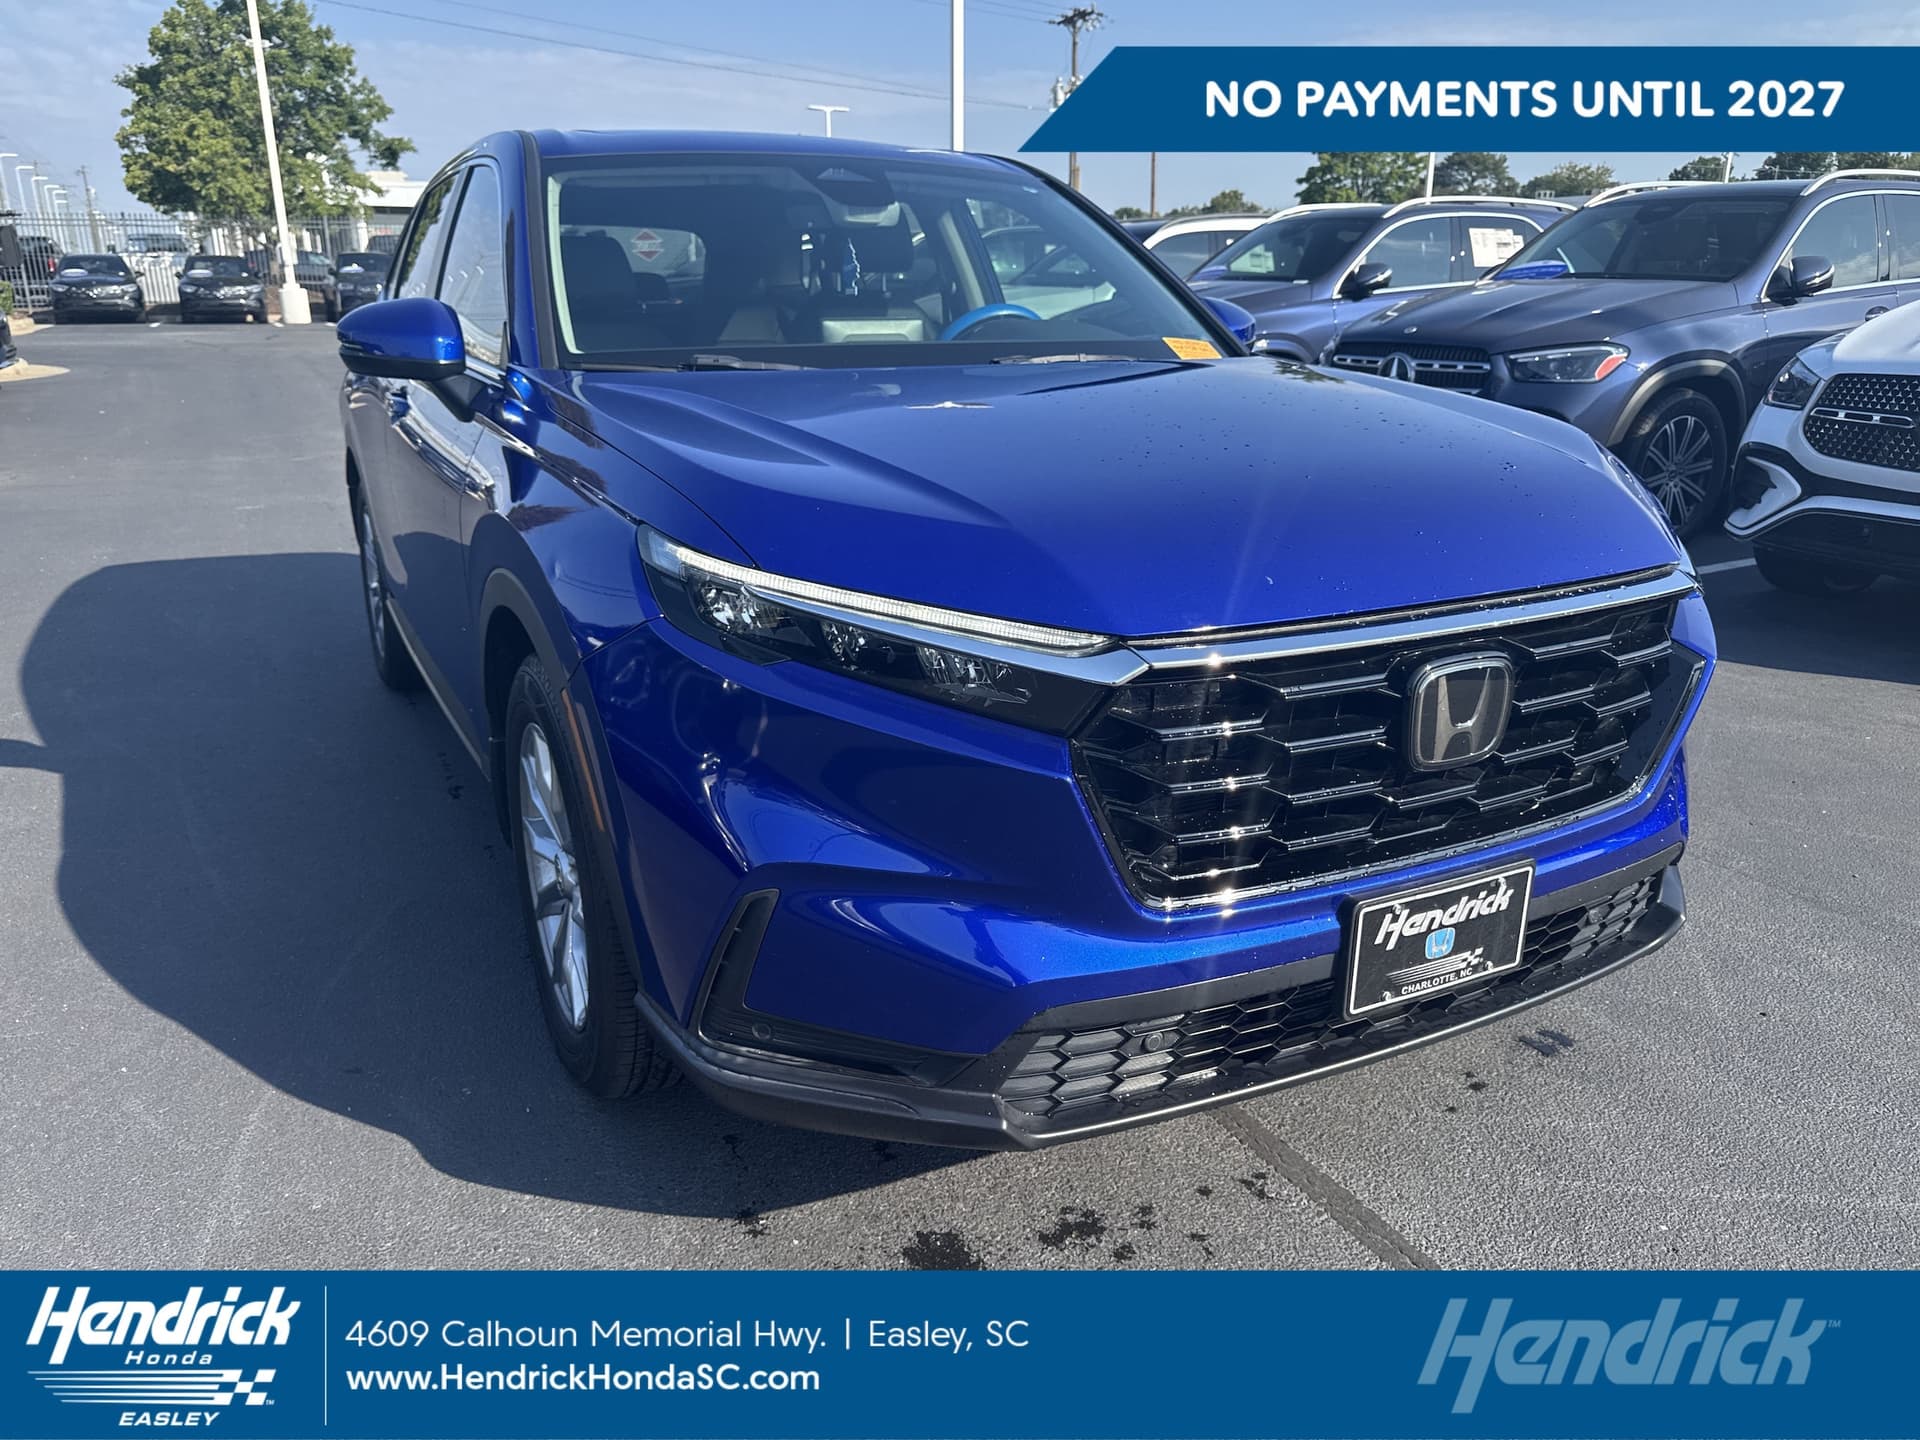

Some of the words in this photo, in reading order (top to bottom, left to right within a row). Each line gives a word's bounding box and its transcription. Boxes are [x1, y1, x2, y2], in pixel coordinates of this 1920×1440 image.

[1374, 885, 1515, 951] Hendrick
[1401, 972, 1458, 995] CHARLOTTE,
[1460, 967, 1473, 978] NC
